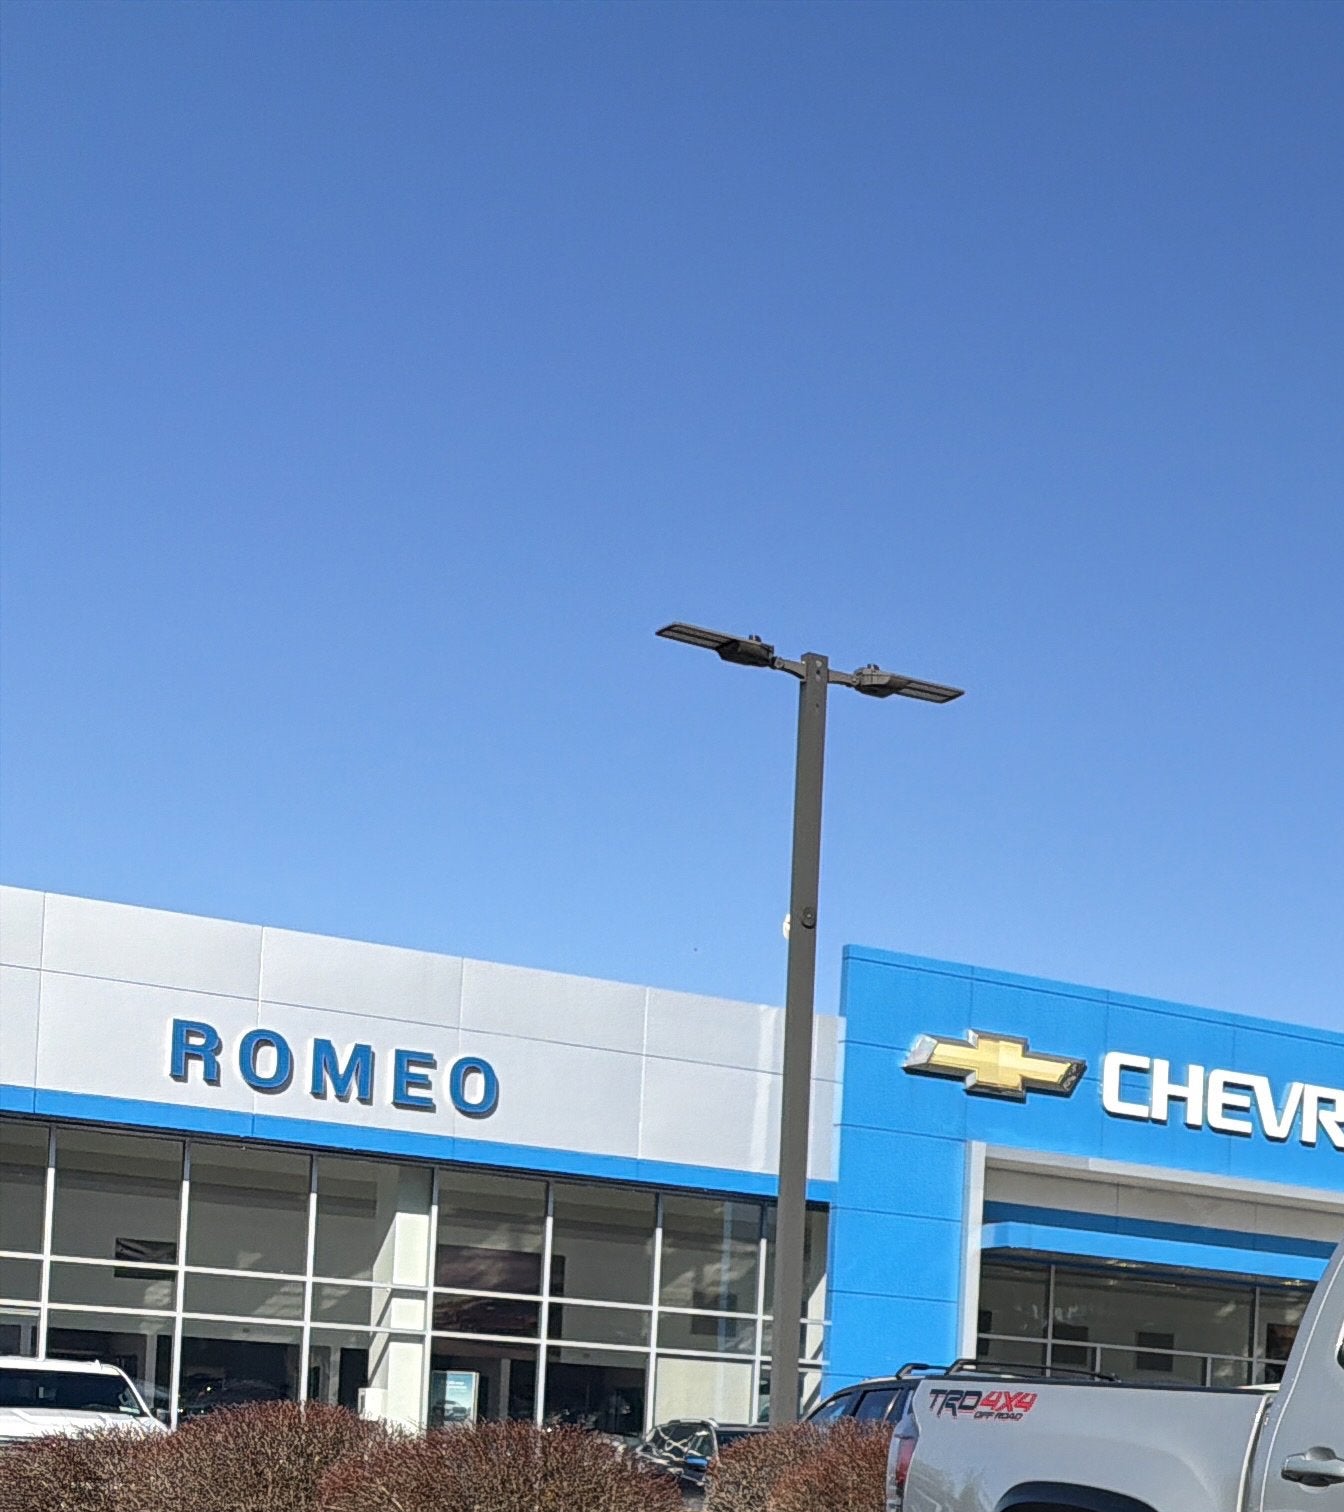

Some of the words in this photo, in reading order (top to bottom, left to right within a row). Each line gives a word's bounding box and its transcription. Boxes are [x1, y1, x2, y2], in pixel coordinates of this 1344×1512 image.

[169, 1018, 499, 1118] ROMEO
[929, 1389, 982, 1418] TRD
[974, 1410, 994, 1420] OFF
[994, 1411, 1023, 1421] ROAD
